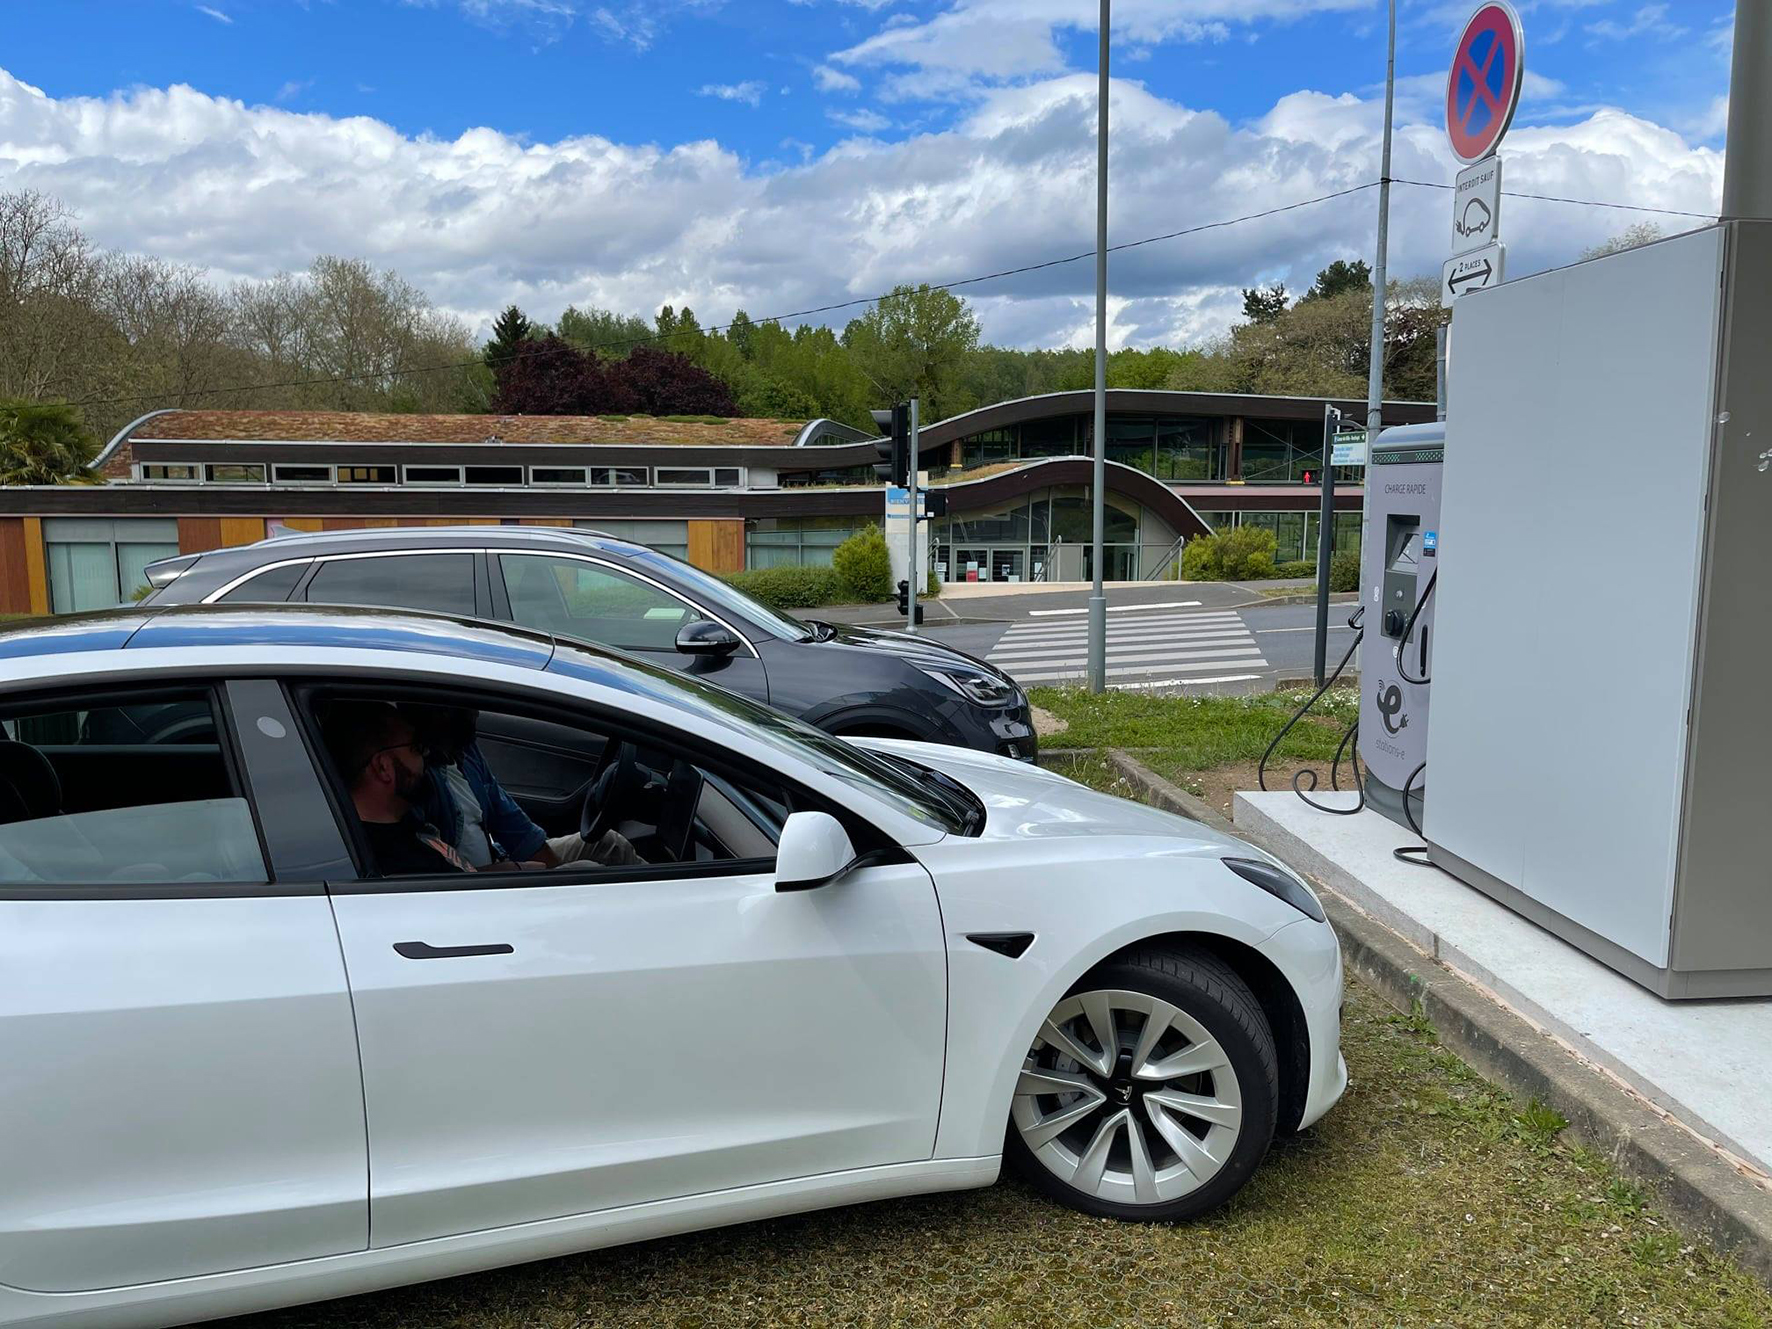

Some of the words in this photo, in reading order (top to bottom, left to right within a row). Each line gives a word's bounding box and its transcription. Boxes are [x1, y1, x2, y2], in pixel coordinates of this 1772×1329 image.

[1457, 177, 1479, 194] INTERDIT
[1480, 170, 1495, 184] SAUF
[1459, 262, 1464, 272] 2
[1464, 259, 1481, 270] PLACES
[1385, 484, 1406, 494] CHARGE
[1407, 484, 1426, 494] RAPIDE
